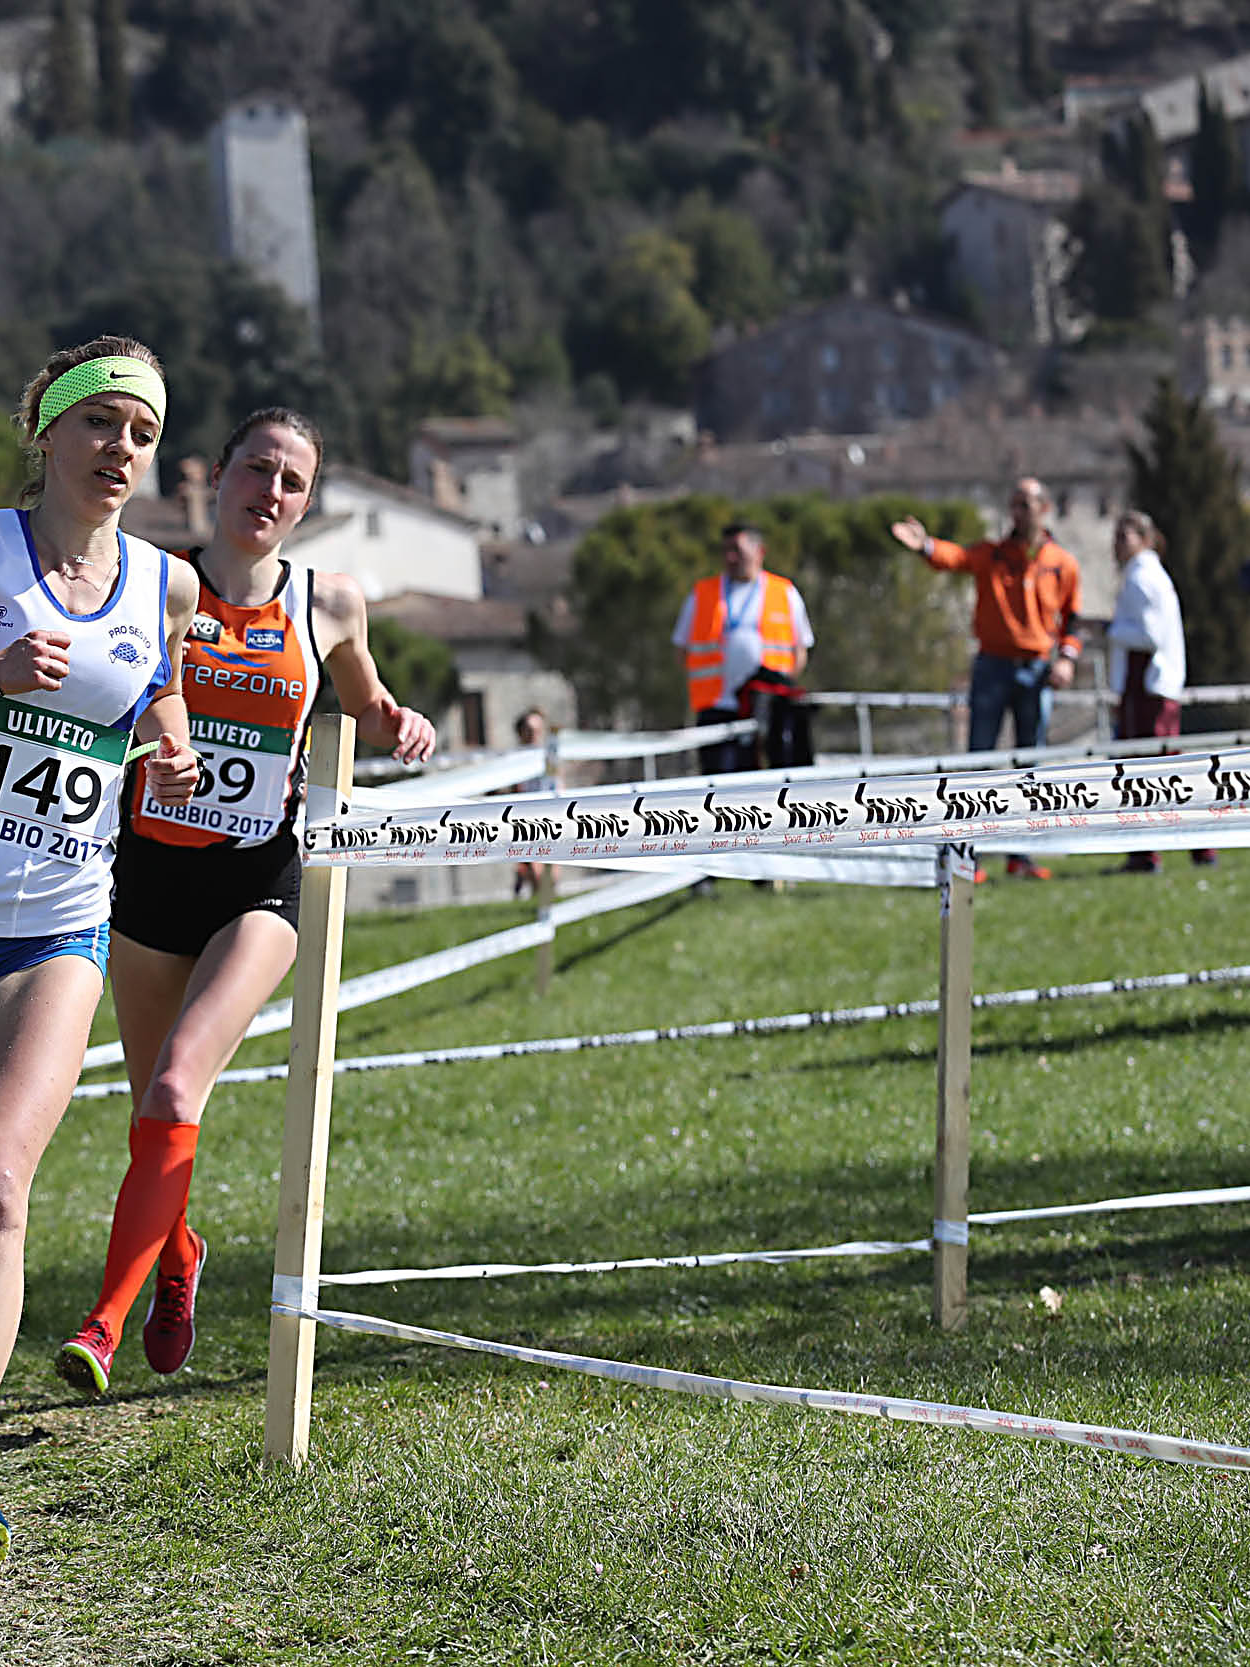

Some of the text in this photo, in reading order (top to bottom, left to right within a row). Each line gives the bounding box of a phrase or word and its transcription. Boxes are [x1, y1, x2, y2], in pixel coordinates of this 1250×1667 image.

[108, 625, 152, 649] PRO SESTO
[181, 663, 304, 700] reezone
[7, 709, 95, 751] ULIVETO
[226, 814, 274, 837] 2017
[858, 829, 879, 842] Sport
[897, 827, 915, 841] Style
[48, 832, 103, 862] 2017
